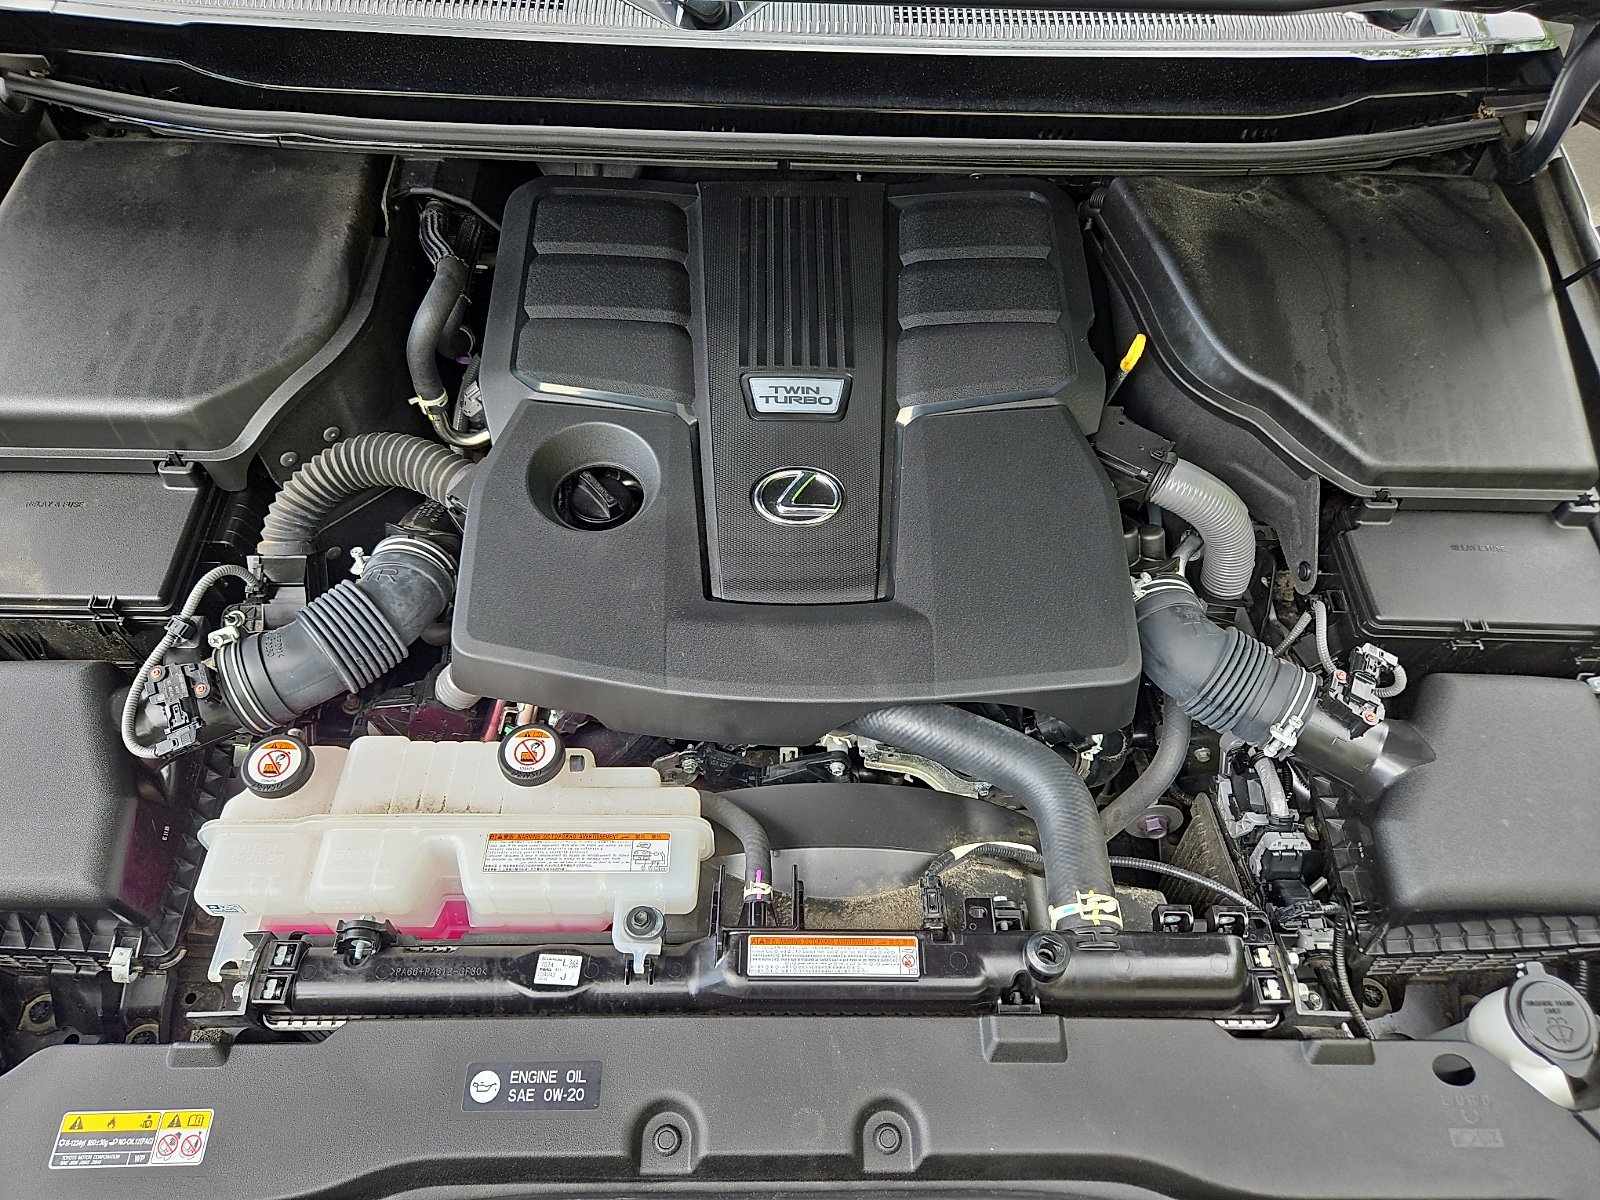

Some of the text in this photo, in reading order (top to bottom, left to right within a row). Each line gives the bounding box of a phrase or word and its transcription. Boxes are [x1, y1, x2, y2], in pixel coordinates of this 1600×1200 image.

[768, 385, 820, 395] TWIN
[759, 395, 834, 405] TURBO
[509, 1069, 587, 1084] ENGINE OIL
[507, 1087, 585, 1102] SAE 0W-20
